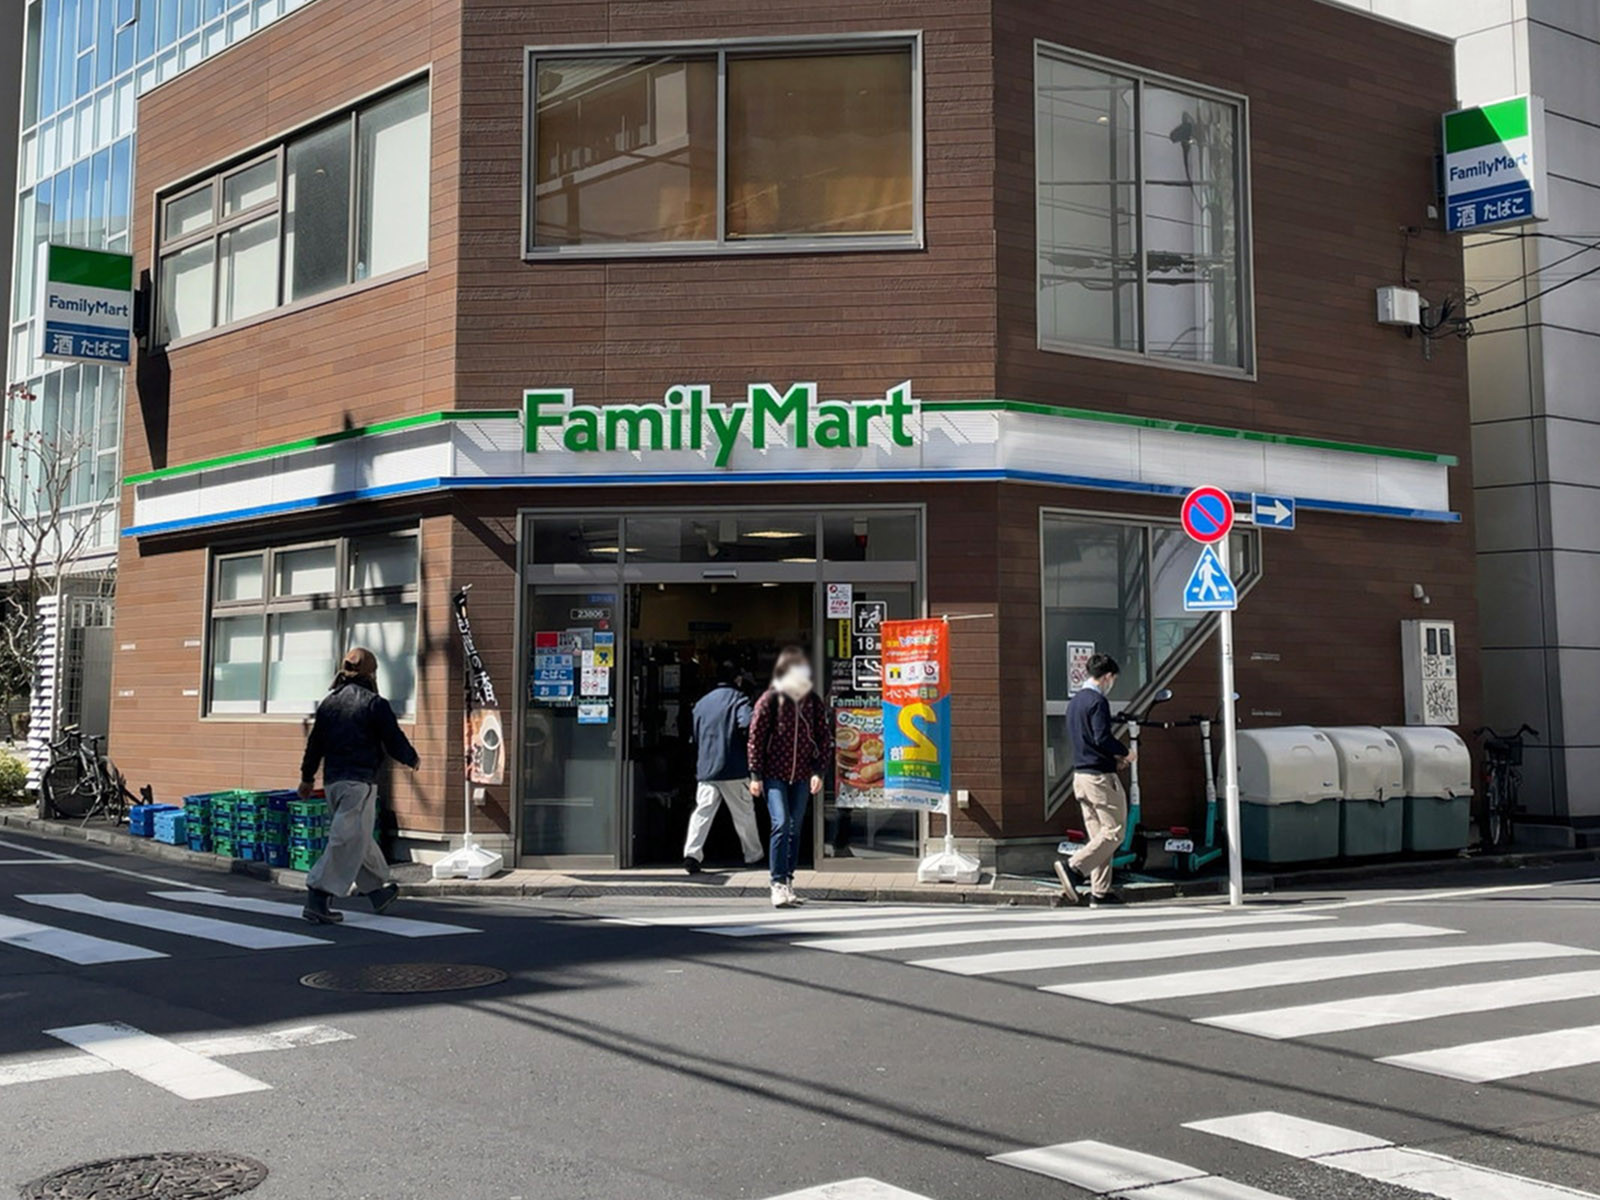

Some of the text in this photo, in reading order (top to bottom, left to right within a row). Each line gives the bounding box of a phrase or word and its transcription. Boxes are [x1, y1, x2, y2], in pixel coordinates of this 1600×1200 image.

[1449, 153, 1528, 181] FamilyMart
[1456, 197, 1526, 228] 酒 たばこ
[48, 295, 129, 319] FamilyMart
[52, 334, 123, 359] 酒 たばこ
[525, 384, 916, 468] FamilyMart
[541, 670, 568, 680] たばこ
[830, 695, 881, 709] FamilyM
